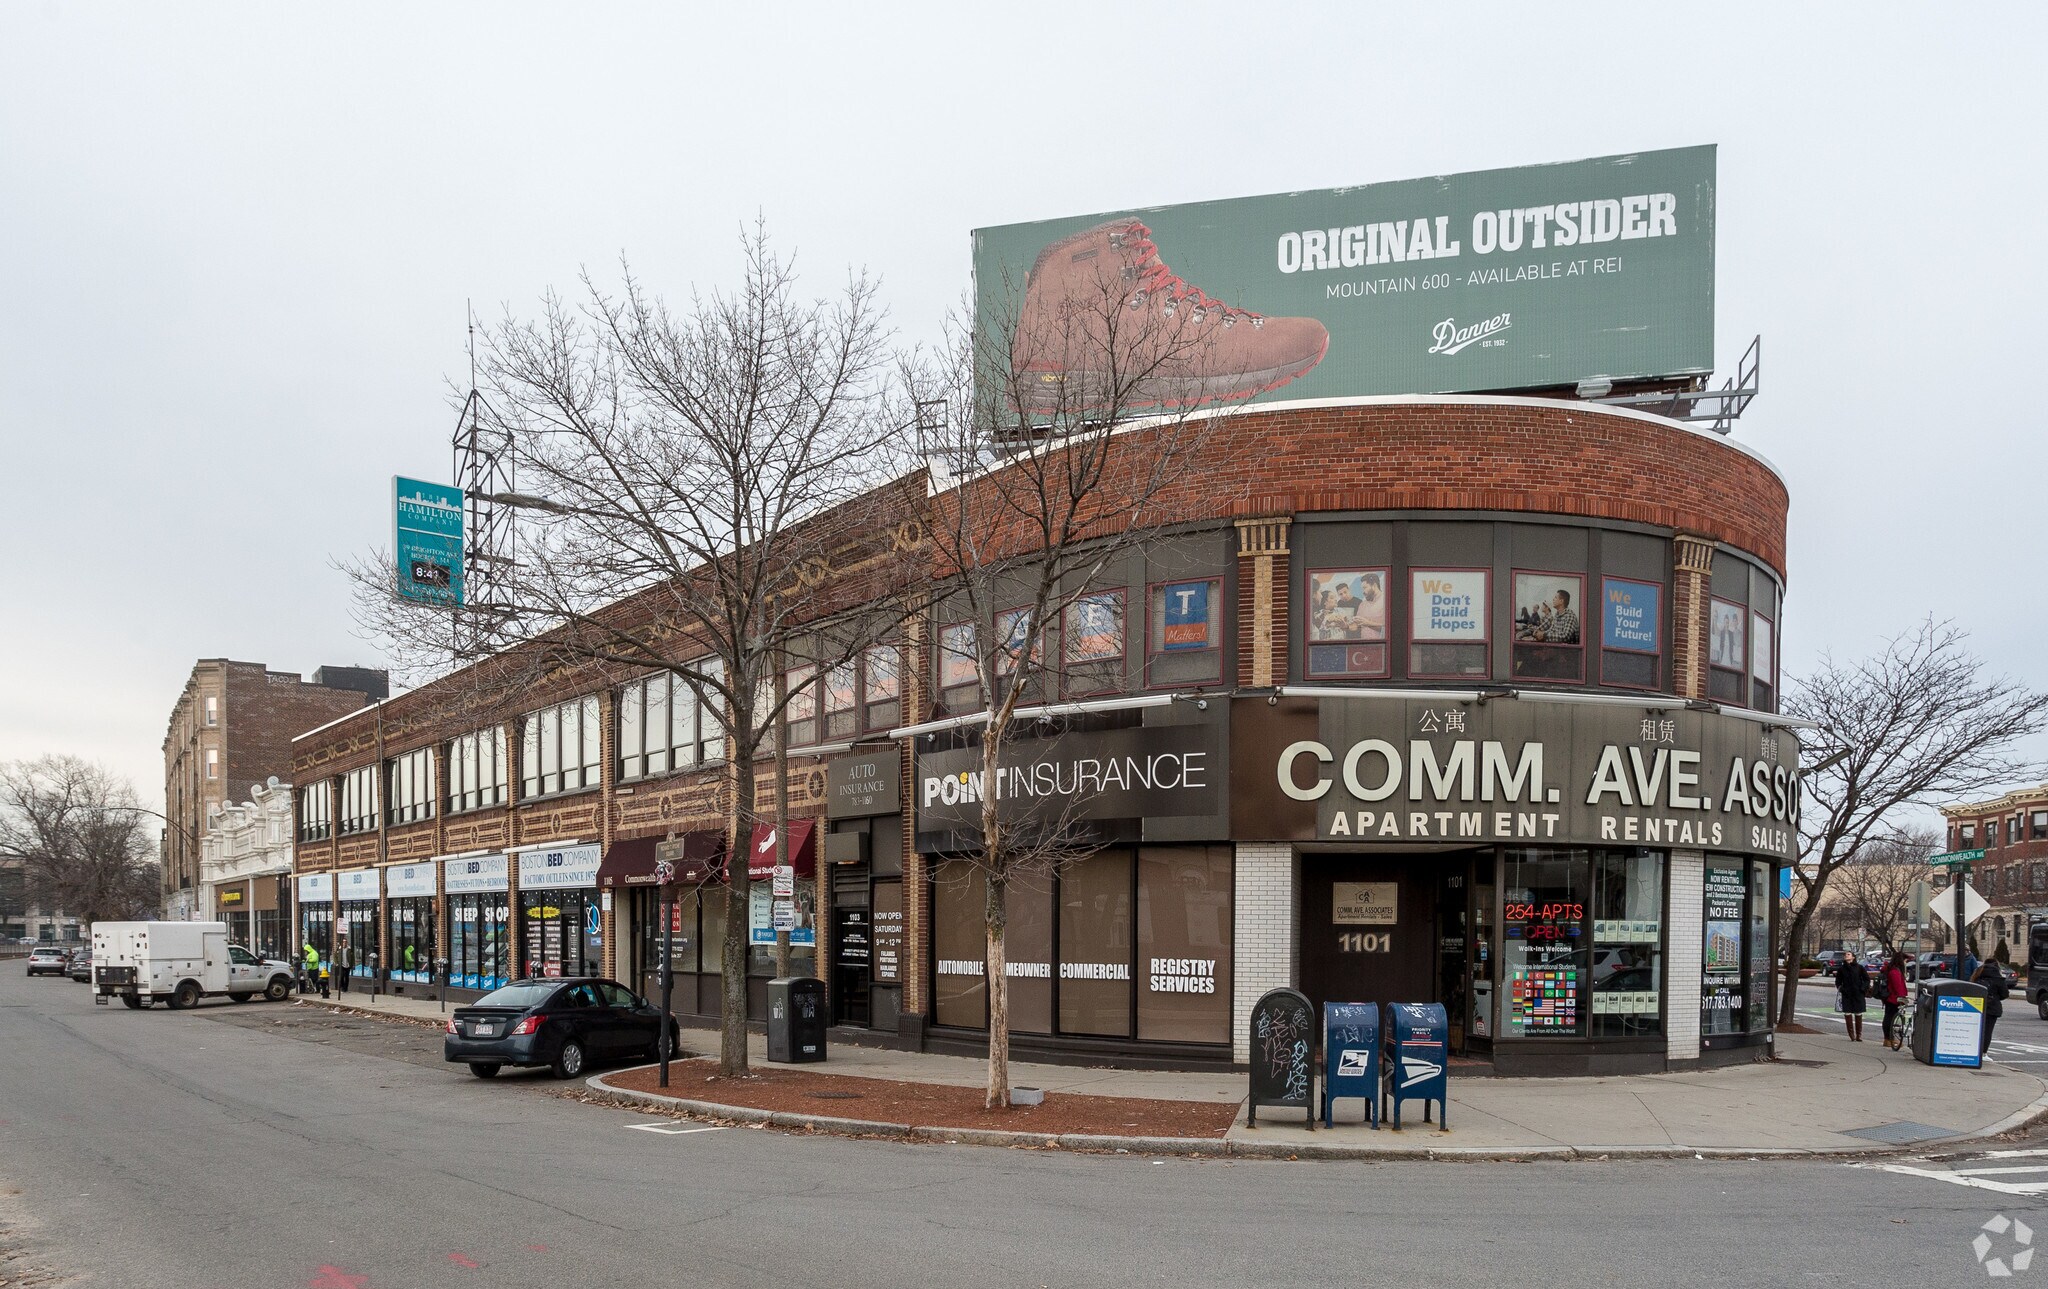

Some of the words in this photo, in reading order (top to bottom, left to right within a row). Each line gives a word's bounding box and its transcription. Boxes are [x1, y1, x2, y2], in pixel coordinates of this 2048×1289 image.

[1278, 215, 1460, 274] ORIGINAL
[1472, 192, 1677, 254] OUTSIDER
[1326, 276, 1416, 299] MOUNTAIN
[1422, 274, 1450, 290] 600
[1467, 262, 1562, 286] AVAILABLE
[1567, 260, 1588, 276] AT
[1594, 257, 1622, 274] REI
[1428, 313, 1511, 354] Danner
[399, 502, 461, 522] HAMILTON
[408, 512, 452, 526] COMPANY
[1422, 580, 1452, 594] We
[1176, 590, 1195, 615] T
[1432, 594, 1471, 605] Don't
[1609, 589, 1631, 605] We
[1432, 606, 1468, 617] Build
[1615, 605, 1642, 618] Build
[1431, 618, 1476, 632] Hopes
[1616, 616, 1641, 629] Your
[1168, 627, 1206, 641] Matters!
[1615, 627, 1652, 641] Future!
[1418, 708, 1466, 733] 公寓
[1640, 718, 1675, 743] 租赁
[848, 763, 876, 779] AUTO
[1009, 752, 1206, 798] INSURANCE
[1277, 738, 1560, 803] COMM.
[1587, 745, 1712, 810] AVE.
[840, 780, 885, 796] INSURANCE
[1329, 811, 1560, 837] APARTMENT
[1601, 816, 1722, 845] RENTALS
[1752, 825, 1787, 853] SALES
[547, 853, 563, 867] BED
[1931, 851, 1976, 864] COMMONWEALTH
[524, 873, 546, 885] FACTORY
[546, 871, 569, 884] OUTLETS
[569, 871, 584, 882] SINCE
[585, 870, 596, 881] 1975
[624, 873, 656, 884] Commonwealth
[1447, 876, 1463, 888] 1101
[1710, 875, 1720, 883] NOW
[1720, 876, 1740, 884] RENTING
[1713, 884, 1746, 893] CONSTRUCTION
[849, 913, 861, 921] 1103
[874, 912, 888, 920] NOW
[887, 912, 903, 920] OPEN
[1506, 903, 1583, 920] 254-APTS
[1710, 907, 1722, 918] NO
[1723, 907, 1738, 918] FEE
[874, 925, 903, 933] SATURDAY
[1525, 925, 1565, 939] OPEN
[1338, 932, 1391, 953] 1101
[938, 959, 984, 976] AUTOMOBILE
[1005, 962, 1051, 978] MEOWNER
[1059, 963, 1130, 980] COMMERCIAL
[1150, 958, 1216, 976] REGISTRY
[1150, 976, 1215, 994] SERVICES
[1703, 976, 1723, 984] INQUIRE
[1723, 977, 1741, 985] WITHIN
